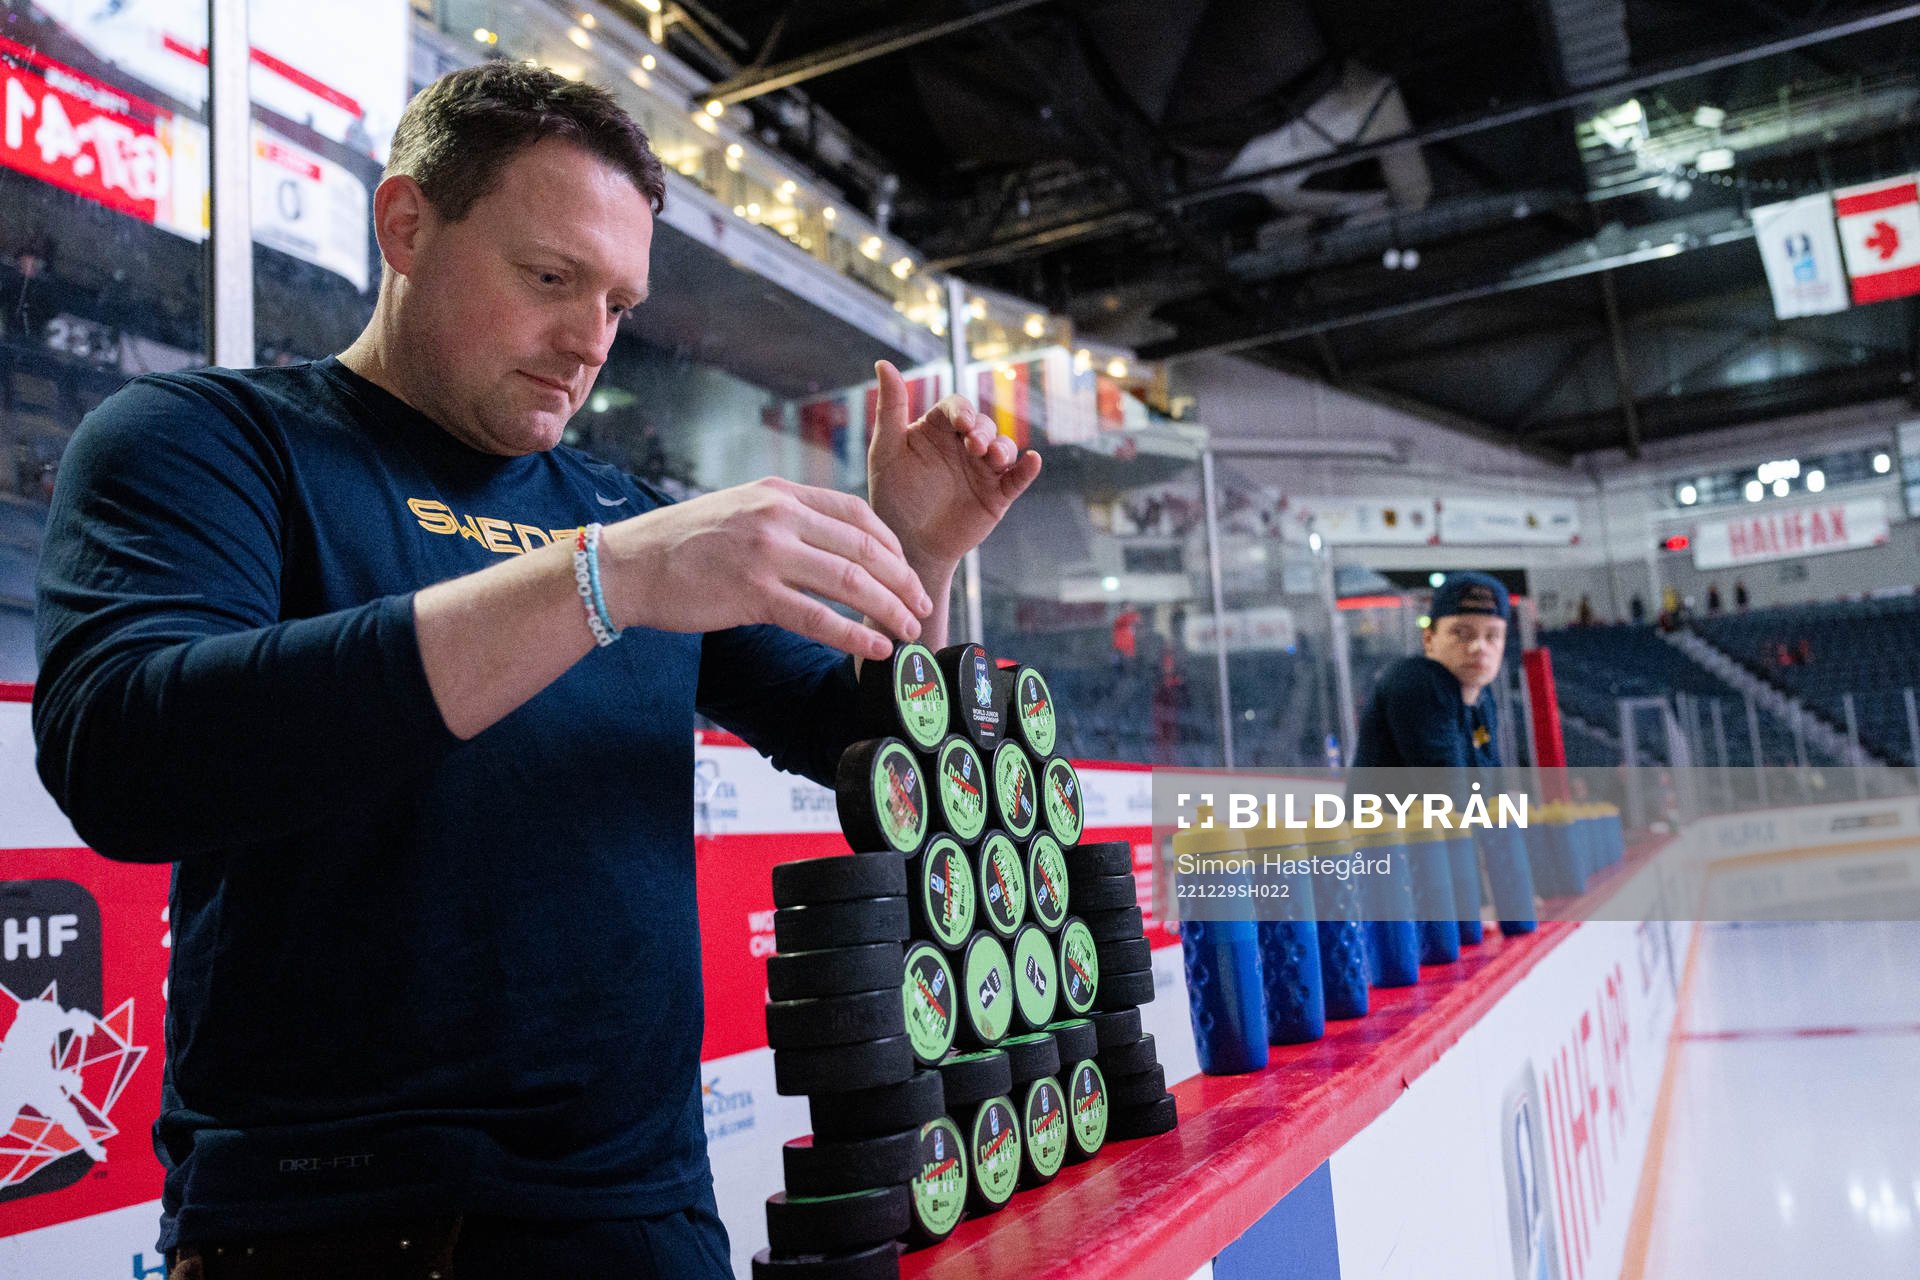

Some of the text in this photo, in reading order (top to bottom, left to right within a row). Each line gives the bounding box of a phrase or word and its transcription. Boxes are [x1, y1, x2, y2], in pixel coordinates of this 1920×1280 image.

[407, 497, 578, 555] SWED
[1727, 503, 1847, 558] HALIFAX
[280, 1153, 375, 1172] DRI-FIT
